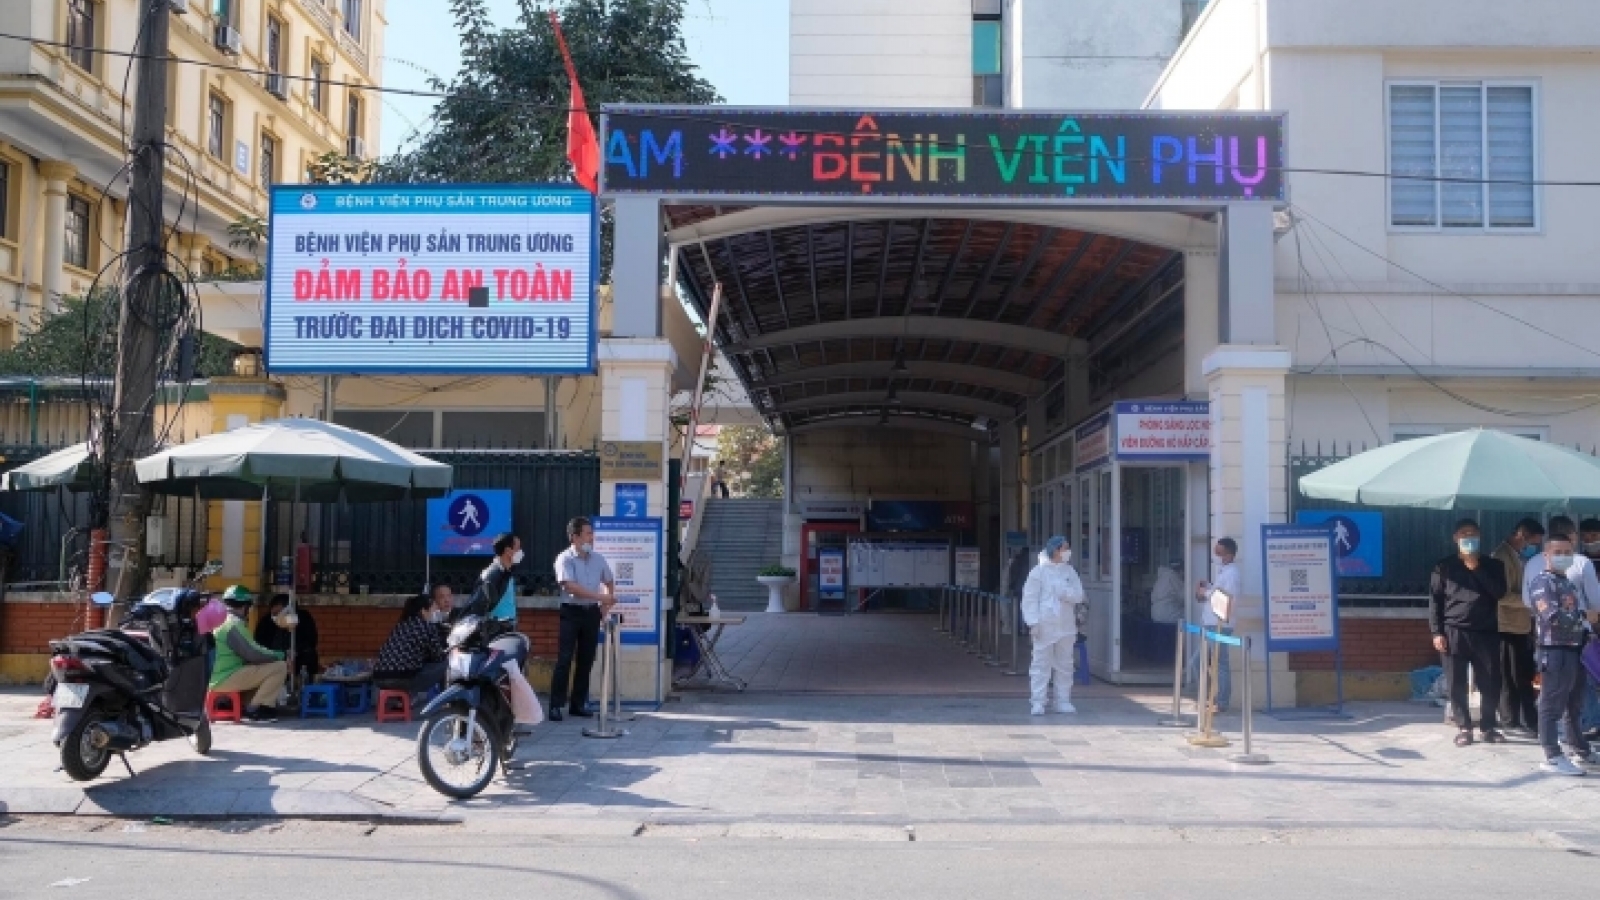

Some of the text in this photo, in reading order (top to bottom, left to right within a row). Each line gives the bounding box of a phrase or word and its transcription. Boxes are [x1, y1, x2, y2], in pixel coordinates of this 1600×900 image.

[988, 117, 1125, 195] VIỆN
[1152, 136, 1266, 197] PHỤ
[336, 193, 572, 208] BỆNH VIỆN PHỤ SẢN TRUNG ƯƠNG
[295, 228, 573, 256] BỆNH VIỆN PHỤ SẢN TRUNG ƯƠNG
[294, 258, 572, 301] ĐẢM BẢO AN TOÀN
[294, 311, 570, 344] TRƯỚC ĐẠI DỊCH COVID-19
[624, 500, 638, 516] 2
